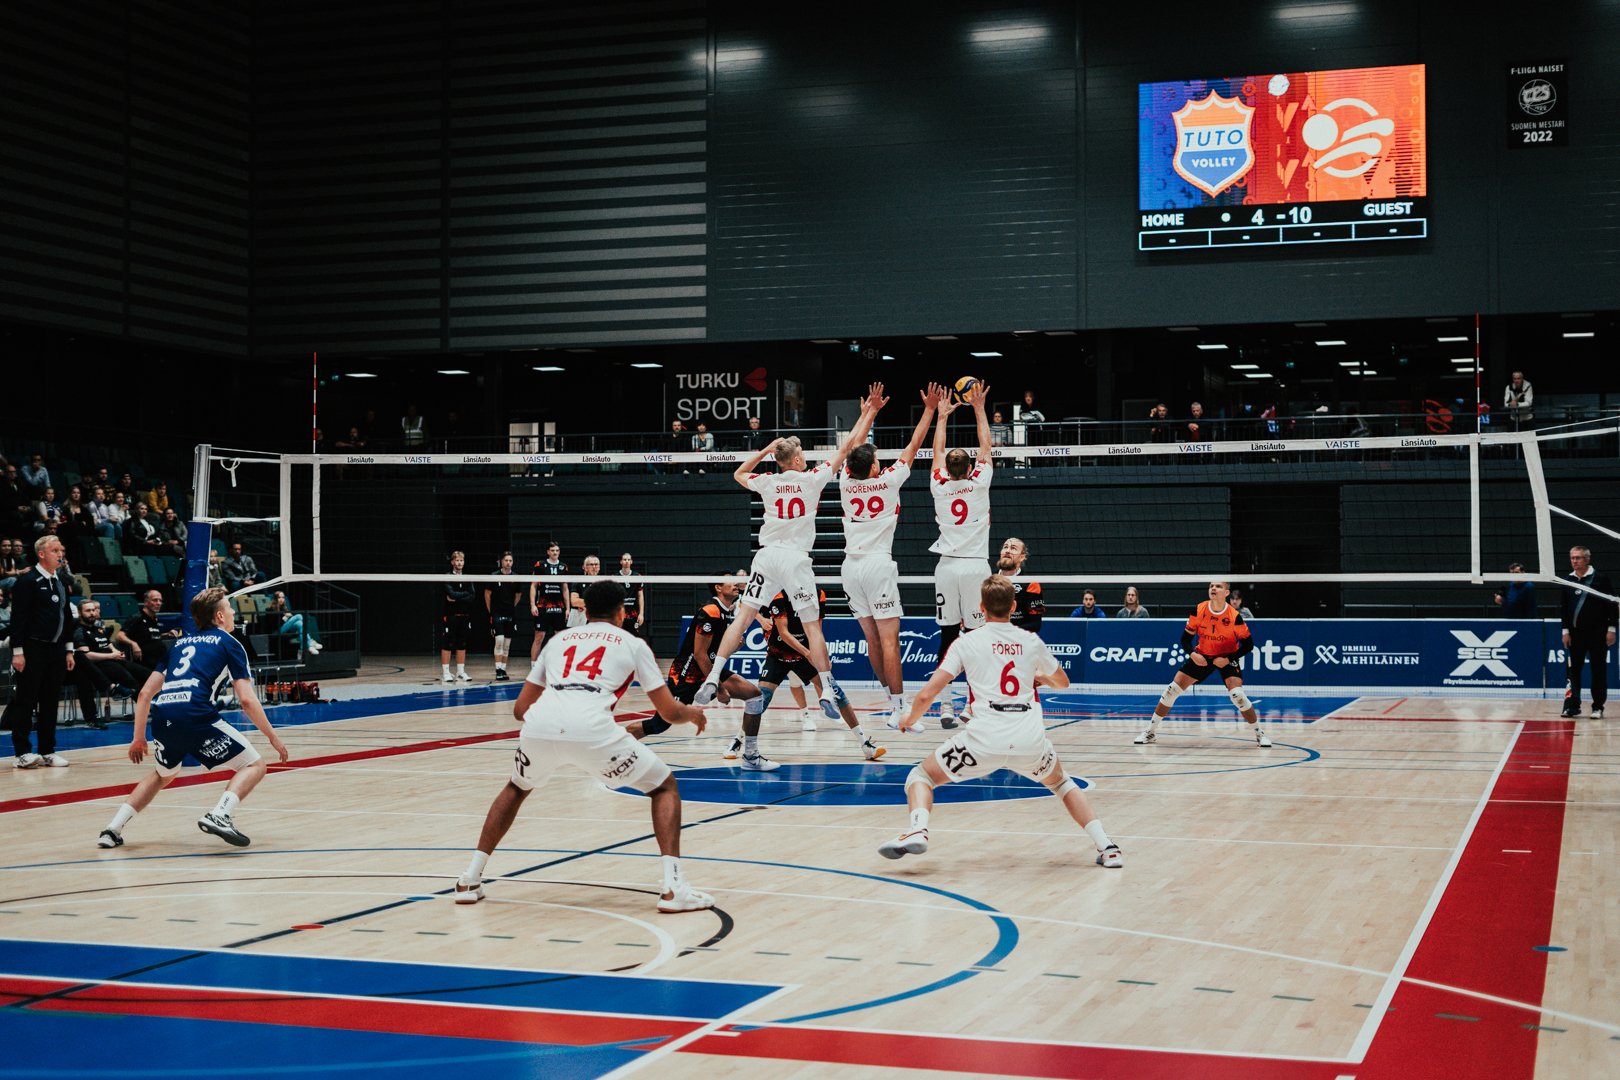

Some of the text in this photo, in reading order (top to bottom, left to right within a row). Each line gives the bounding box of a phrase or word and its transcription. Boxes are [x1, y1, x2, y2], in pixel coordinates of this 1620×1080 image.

[1511, 64, 1564, 75] F-LIIGA NAISET
[1511, 120, 1565, 131] SUOMEN MESTARI
[1184, 129, 1243, 147] TUTO
[1523, 130, 1553, 143] 2022
[1191, 156, 1236, 168] VOLLEY
[1363, 202, 1413, 216] GUEST
[1141, 213, 1184, 227] HOME
[1251, 208, 1264, 225] 4
[676, 372, 739, 389] TURKU
[677, 396, 767, 421] SPORT
[1178, 444, 1212, 452] VAISTE
[1251, 442, 1286, 451] LänsiAuto
[1325, 440, 1360, 448] VAISTE
[1401, 438, 1437, 447] LänsiAuto
[1038, 447, 1070, 455] VAISTE
[1108, 446, 1141, 455] LänsiAuto
[463, 455, 491, 463] LänsiAuto
[582, 455, 611, 463] LänsiAuto
[643, 454, 672, 462] VAISTE
[706, 454, 736, 462] LänsiAuto
[775, 482, 802, 494] SIIRILÄ
[774, 497, 805, 520] 10
[850, 495, 884, 519] 29
[951, 498, 968, 525] 9
[562, 632, 622, 645] GROFFIER
[992, 640, 1023, 656] FÖRSTI
[1089, 646, 1168, 662] CRAFT
[1457, 647, 1509, 660] SEC
[172, 645, 196, 677] 3
[563, 645, 607, 681] 14
[1342, 654, 1419, 665] MEHILÄINEN
[1000, 660, 1020, 697] 6
[203, 737, 232, 758] VICHY
[603, 751, 639, 779] VICHY
